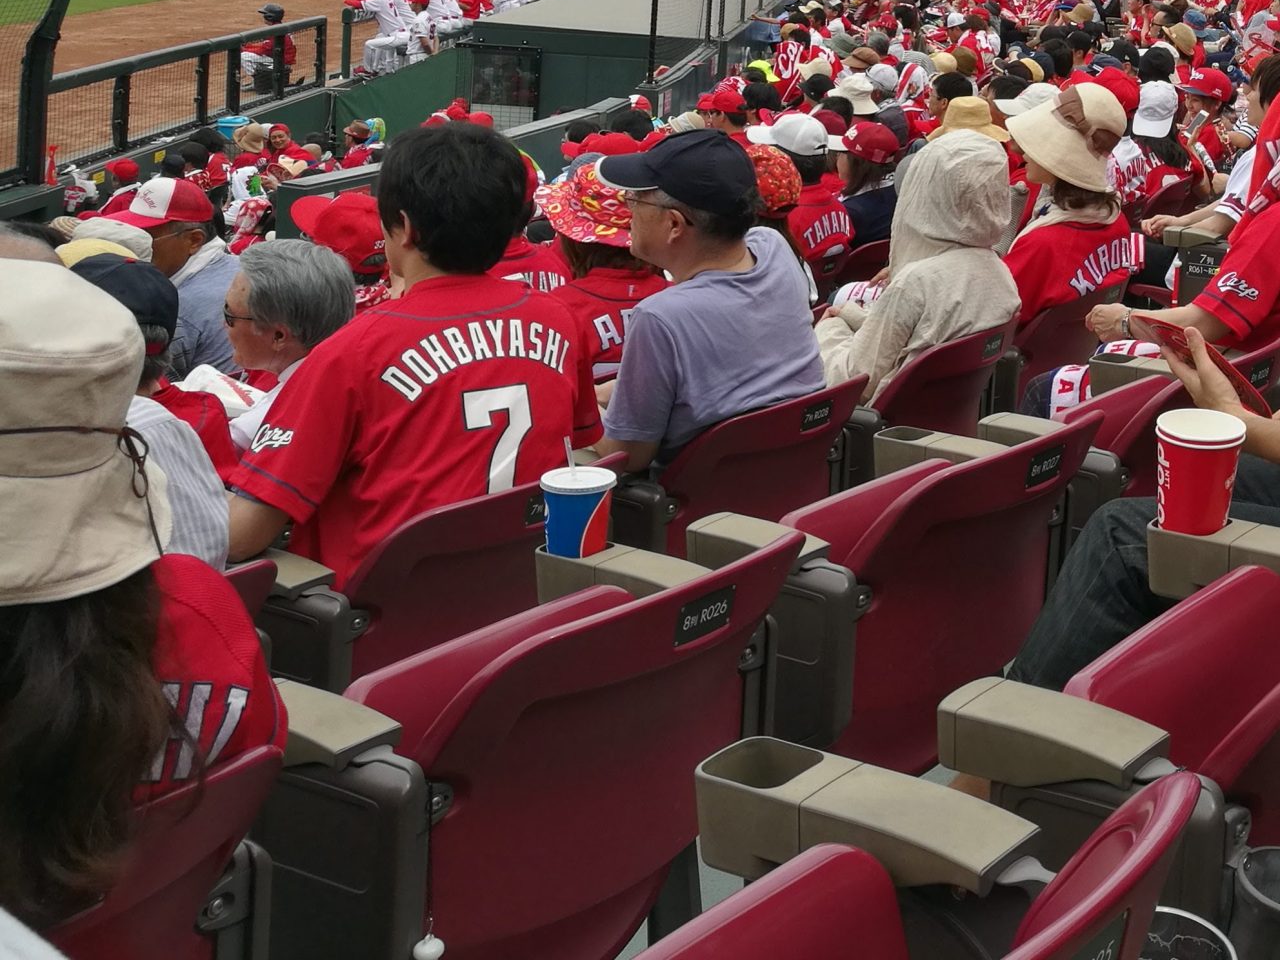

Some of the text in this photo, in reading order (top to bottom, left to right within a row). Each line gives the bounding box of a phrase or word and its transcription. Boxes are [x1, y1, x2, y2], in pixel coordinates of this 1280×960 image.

[1217, 272, 1259, 300] Carp
[380, 319, 570, 402] DOHBAYASHI
[251, 424, 293, 453] Carp
[462, 384, 532, 495] 7
[700, 601, 727, 623] R026
